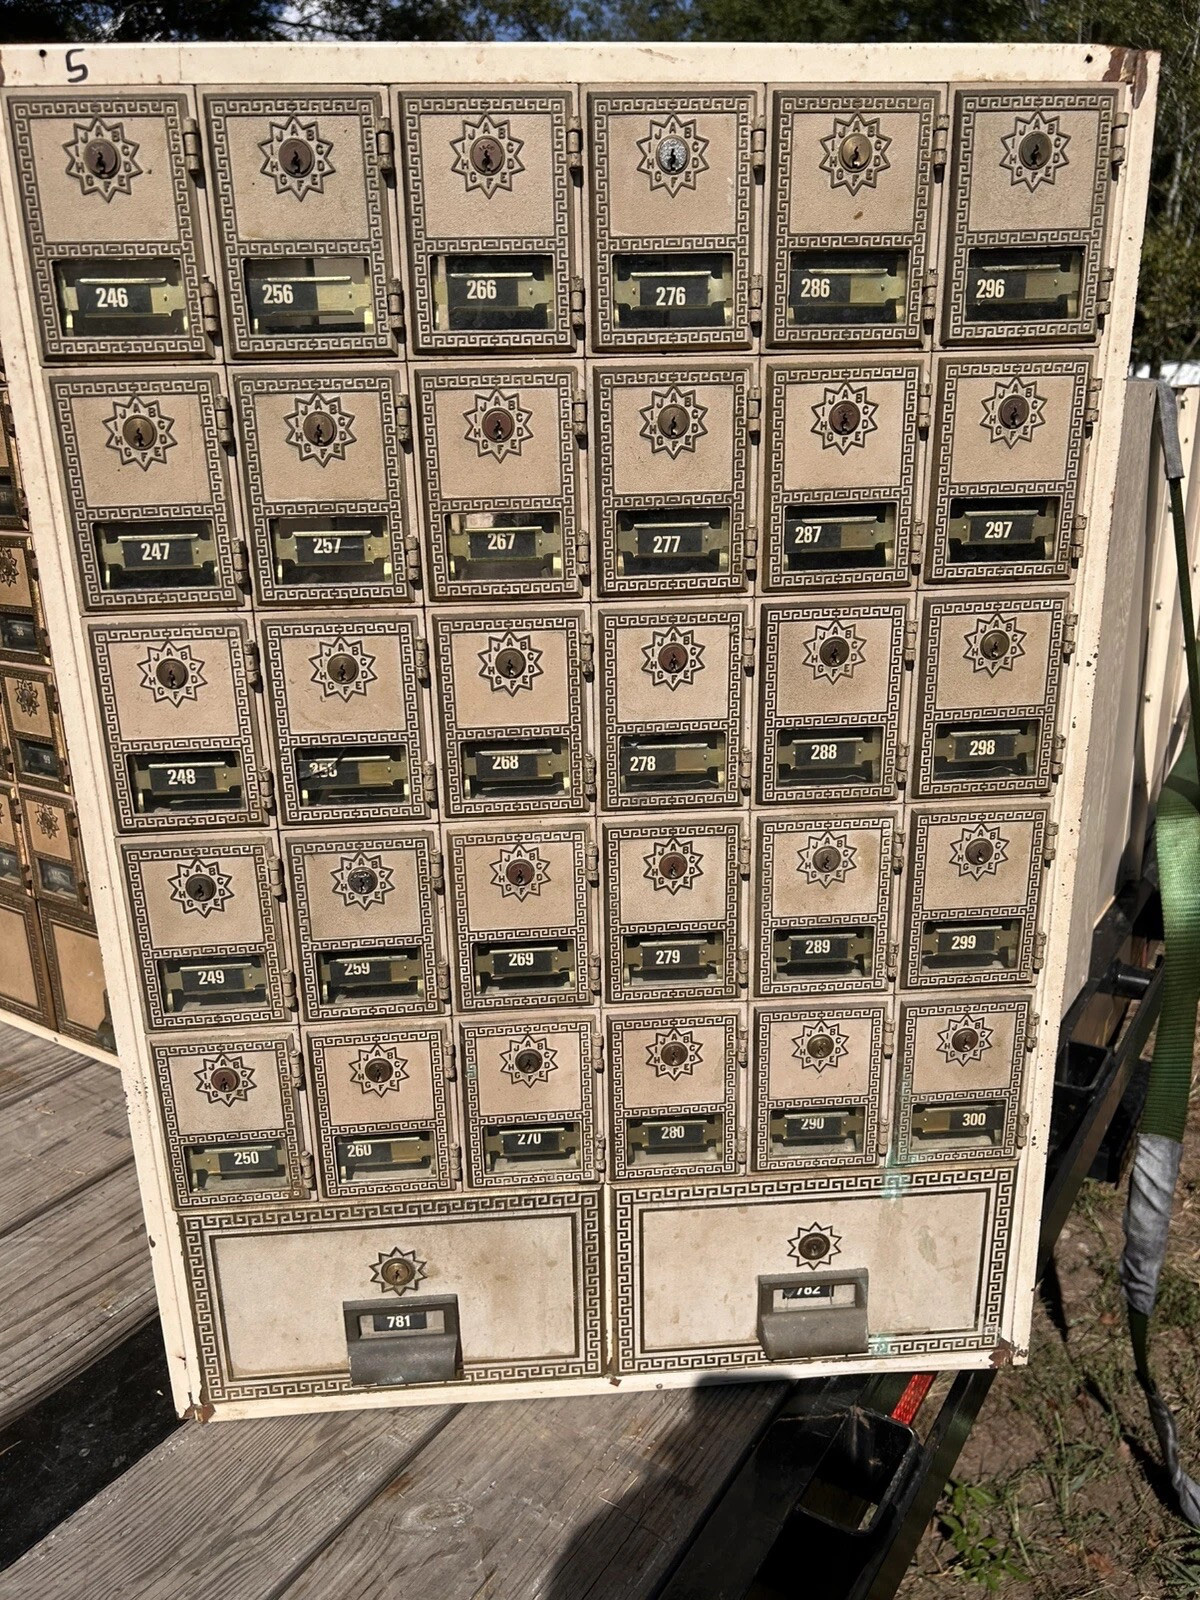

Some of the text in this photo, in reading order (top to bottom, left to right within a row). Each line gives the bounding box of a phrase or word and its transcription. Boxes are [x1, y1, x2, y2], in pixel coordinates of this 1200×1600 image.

[262, 284, 293, 304] 256
[467, 280, 497, 299] 266
[801, 278, 830, 298] 286
[976, 279, 1005, 298] 296
[96, 288, 128, 308] 246
[656, 287, 686, 306] 276
[795, 526, 822, 544] 287
[985, 522, 1013, 539] 297
[313, 537, 341, 554] 257
[487, 533, 516, 550] 267
[653, 536, 681, 553] 277
[141, 543, 170, 561] 247
[811, 744, 837, 760] 288
[969, 740, 996, 756] 298
[492, 756, 519, 770] 268
[630, 756, 656, 772] 278
[167, 769, 195, 785] 248
[805, 940, 830, 954] 289
[952, 935, 976, 950] 299
[509, 952, 534, 967] 269
[656, 949, 681, 965] 279
[344, 962, 371, 976] 259
[198, 970, 225, 986] 249
[801, 1117, 825, 1130] 290
[962, 1112, 987, 1126] 300
[517, 1133, 542, 1146] 270
[661, 1126, 685, 1139] 280
[234, 1151, 259, 1165] 250
[347, 1144, 372, 1157] 260
[387, 1315, 411, 1328] 781
